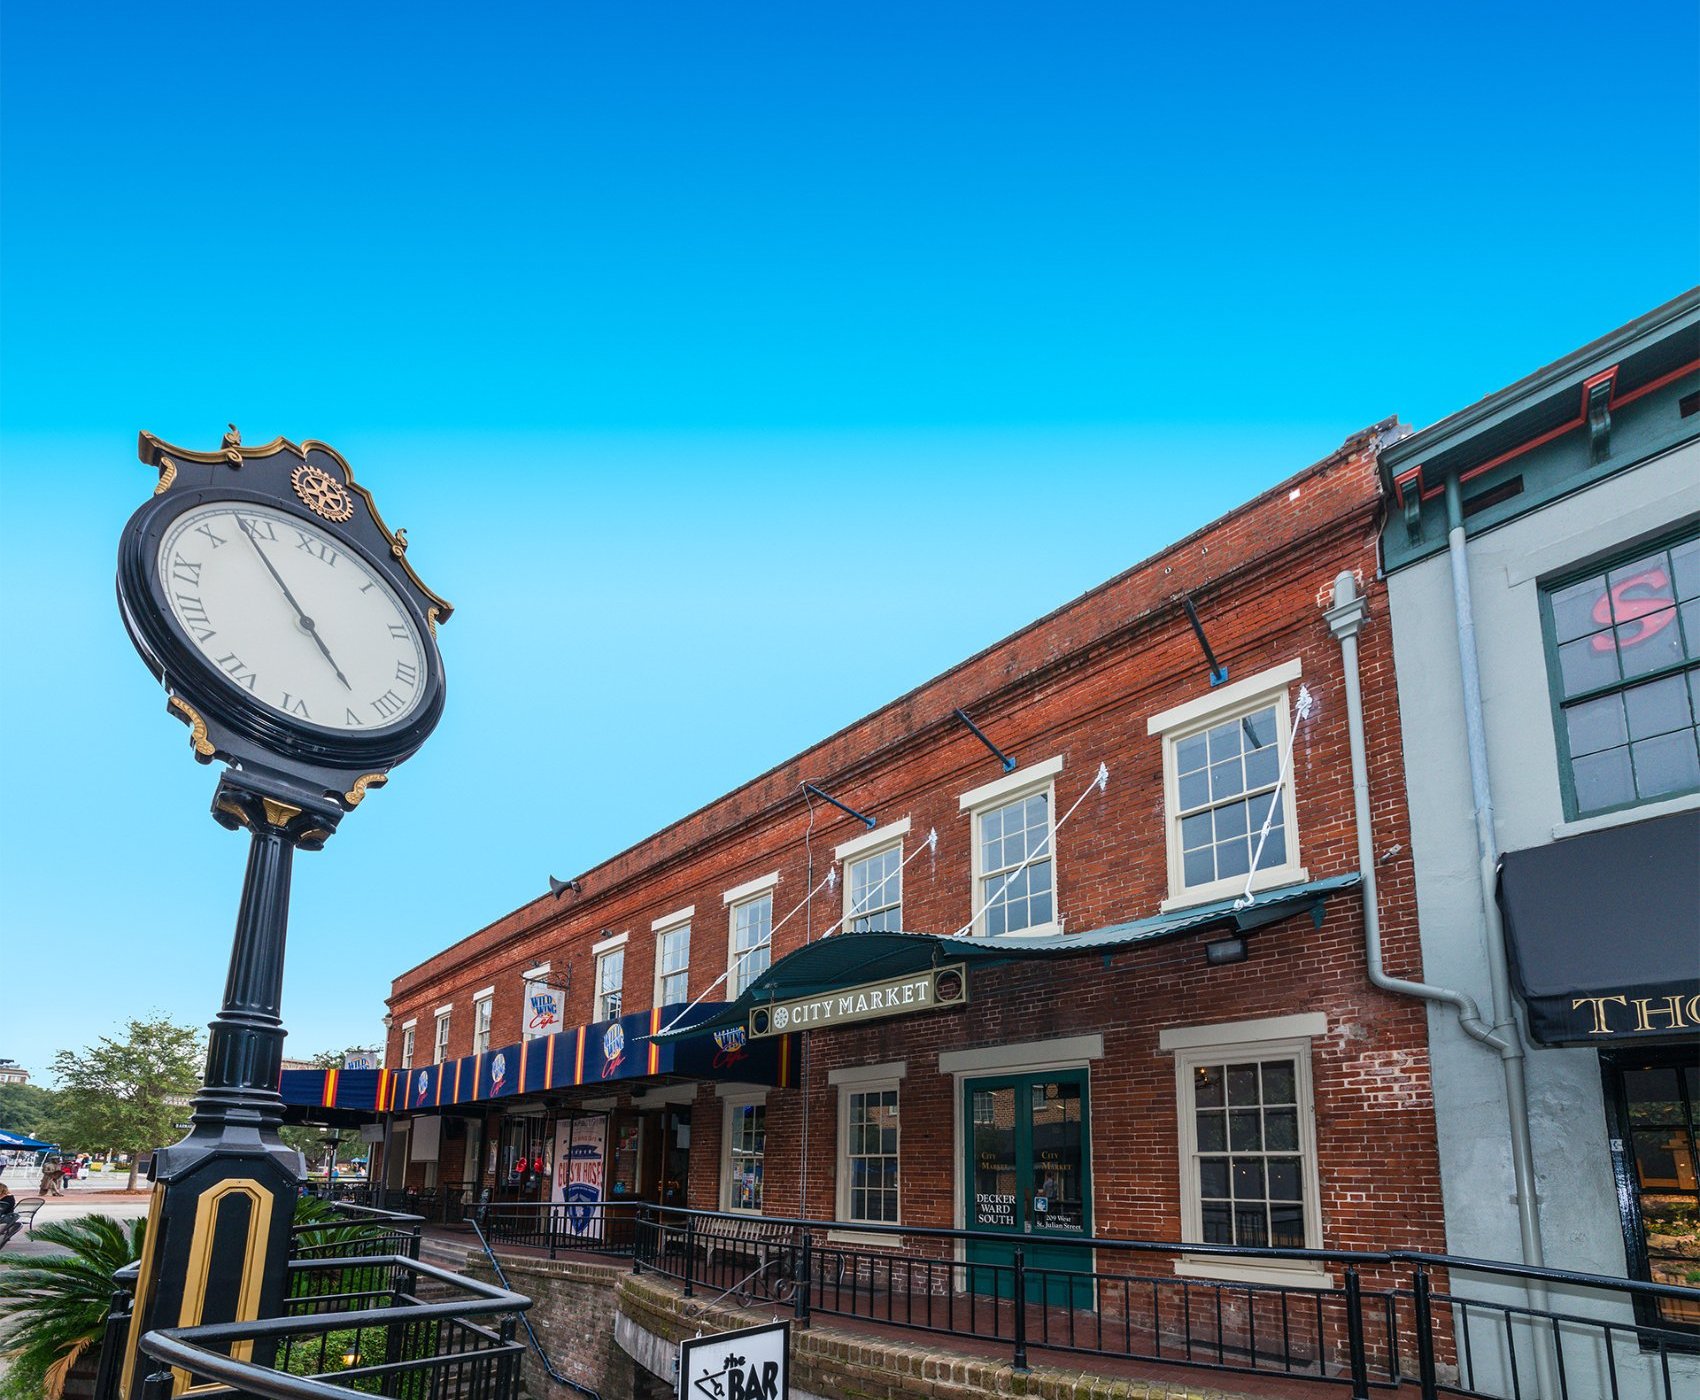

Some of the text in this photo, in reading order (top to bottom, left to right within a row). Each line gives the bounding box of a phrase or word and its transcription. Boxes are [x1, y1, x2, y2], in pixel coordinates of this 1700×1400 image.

[196, 523, 227, 549] X
[297, 531, 339, 568] XII
[172, 551, 202, 588] IX
[358, 580, 376, 596] I
[1591, 567, 1678, 653] S
[386, 622, 410, 642] II
[214, 651, 258, 692] VII
[394, 658, 417, 688] III
[279, 690, 313, 720] VI
[344, 706, 364, 726] V
[369, 688, 407, 720] IIII
[530, 995, 553, 1008] WILD
[791, 980, 929, 1025] CITY MARKET
[1041, 1151, 1059, 1160] CITY
[976, 1193, 1016, 1205] DECKER
[980, 1204, 1011, 1214] WARD
[978, 1214, 1015, 1225] SOUTH
[723, 1352, 747, 1371] the
[727, 1360, 779, 1400] BAR
